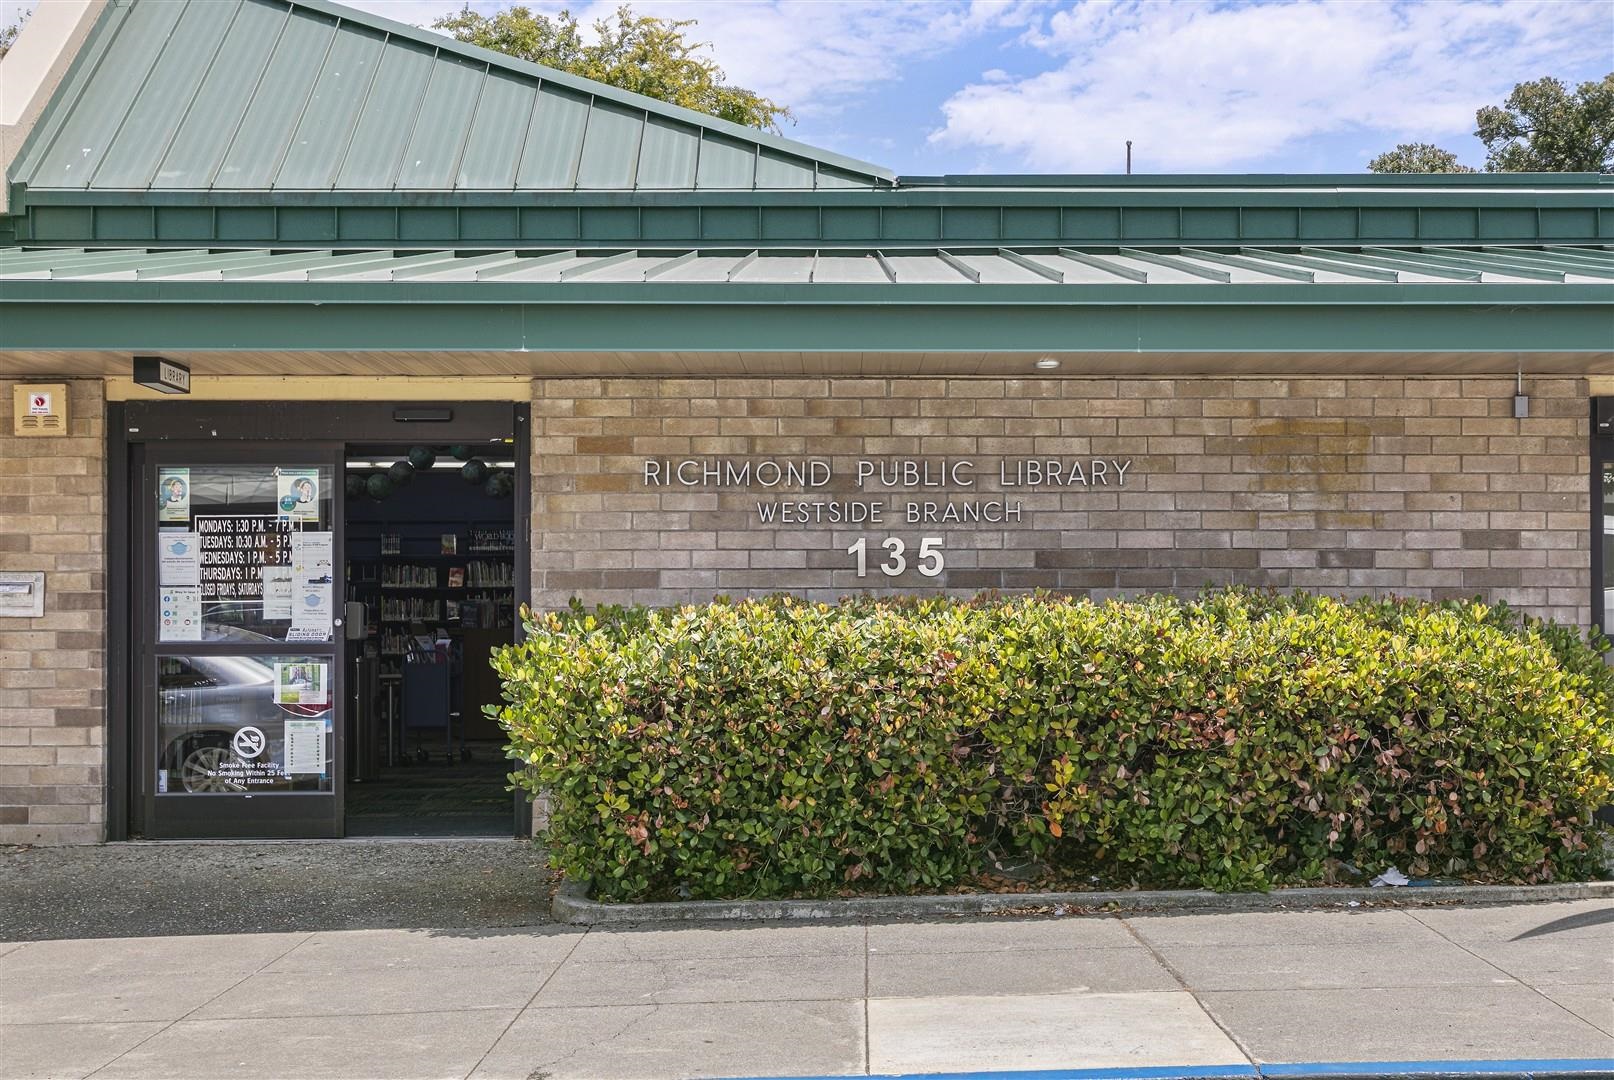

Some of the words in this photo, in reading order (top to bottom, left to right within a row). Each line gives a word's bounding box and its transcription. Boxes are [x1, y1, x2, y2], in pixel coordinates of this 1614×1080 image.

[164, 367, 185, 384] LIBRARY
[644, 461, 831, 487] RICHMOND
[858, 461, 973, 486] PUBLIC
[1001, 460, 1131, 486] LIBRARY
[757, 502, 883, 523] WESTSIDE
[907, 501, 1022, 523] BRANCH
[199, 519, 234, 532] MONDAYS:
[235, 519, 250, 532] 1:30
[251, 519, 266, 532] P.M.
[200, 535, 234, 548] TUESDAYS:
[235, 535, 253, 548] 10:30
[254, 535, 268, 548] A.M.
[276, 535, 281, 548] 5
[200, 551, 245, 564] WEDNESDAYS:
[252, 551, 267, 564] P.M.
[275, 551, 280, 564] 5
[847, 537, 945, 577] 135
[200, 567, 243, 580] THURSDAYS:
[200, 583, 216, 596] CLOSED
[237, 583, 264, 596] SATURDAYS
[257, 762, 280, 771] Facility
